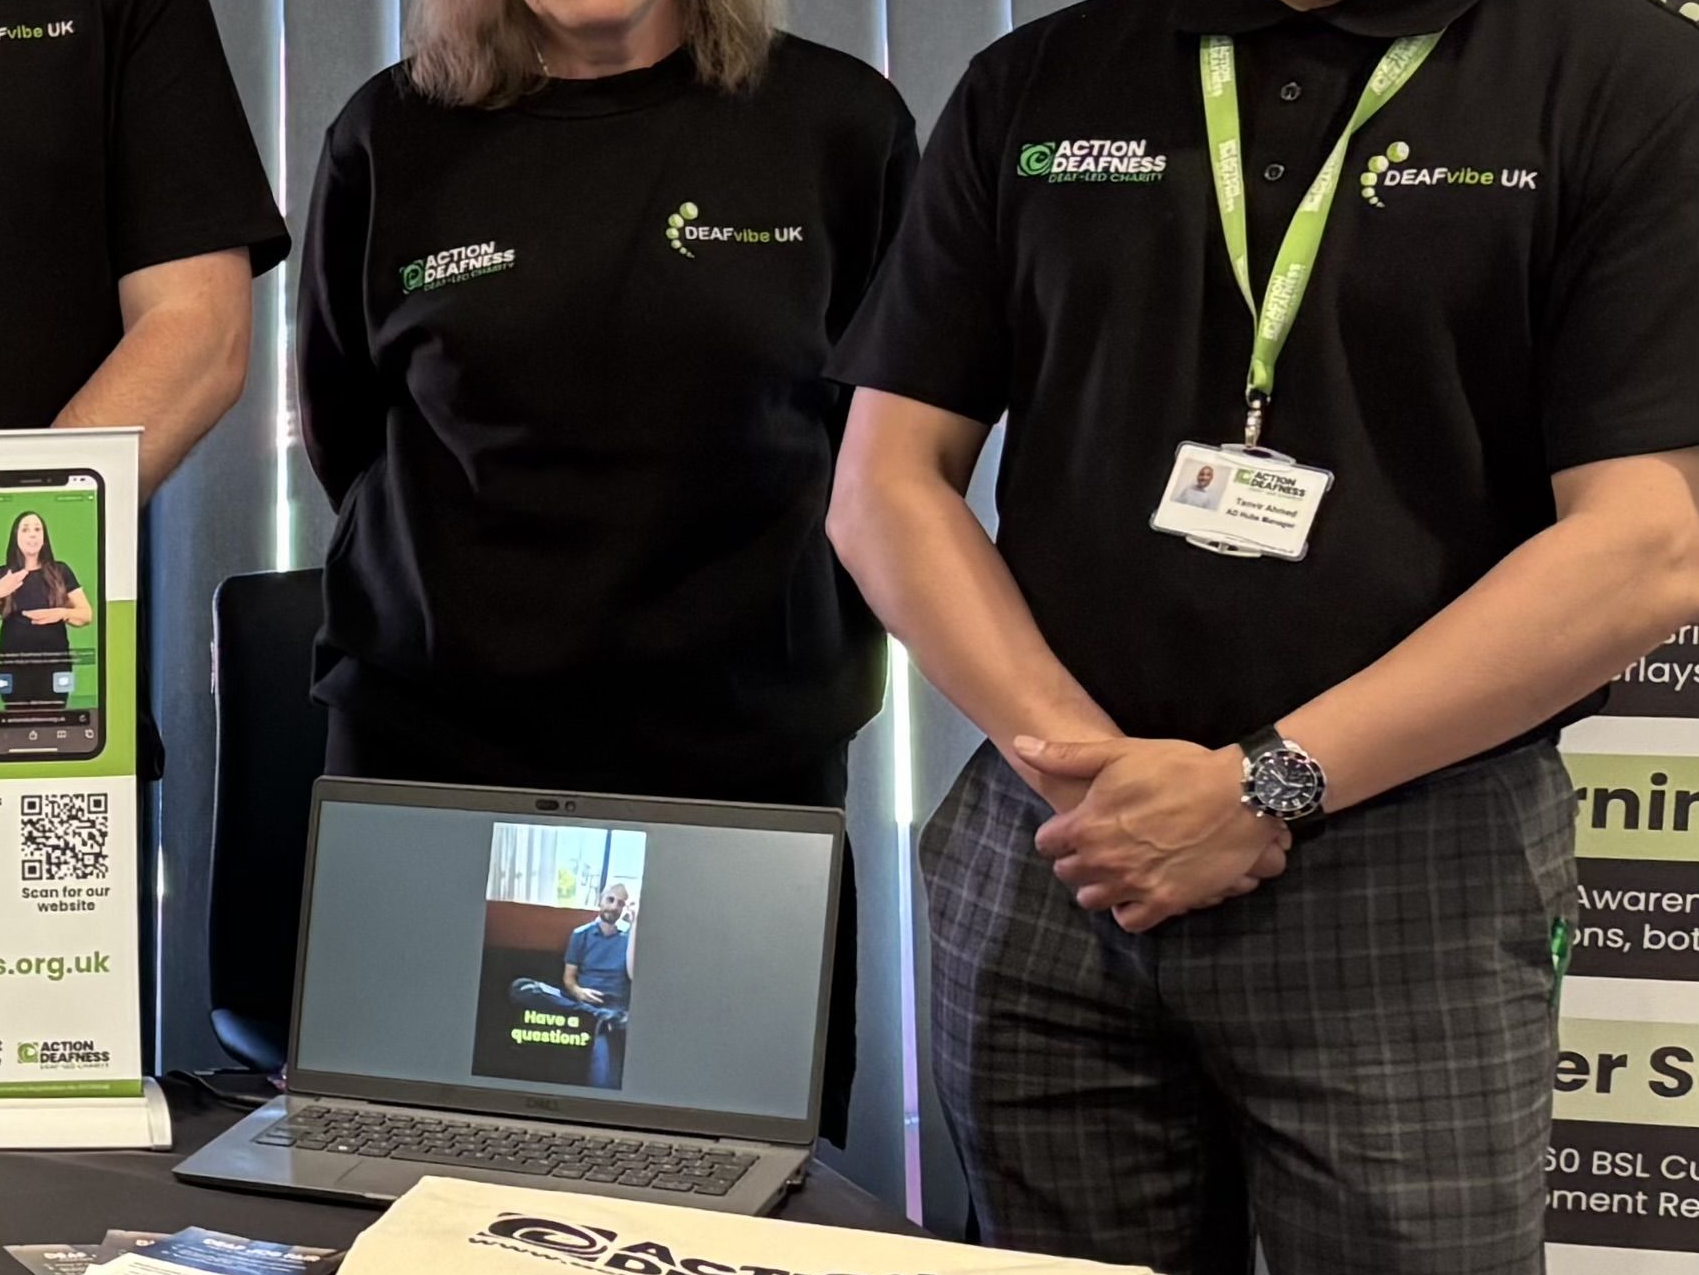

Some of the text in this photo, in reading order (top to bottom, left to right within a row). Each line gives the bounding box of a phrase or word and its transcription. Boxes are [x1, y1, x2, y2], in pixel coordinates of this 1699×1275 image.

[1055, 140, 1146, 157] ACTION
[1051, 154, 1166, 174] DEAFNESS
[1384, 167, 1537, 189] DEAFvibe UK
[685, 226, 802, 243] DEAFvibe UK
[425, 241, 495, 271] ACTION
[425, 249, 515, 283] DEAFNESS
[524, 1011, 578, 1028] Have a
[511, 1027, 590, 1047] question?
[1591, 1150, 1651, 1179] BSL
